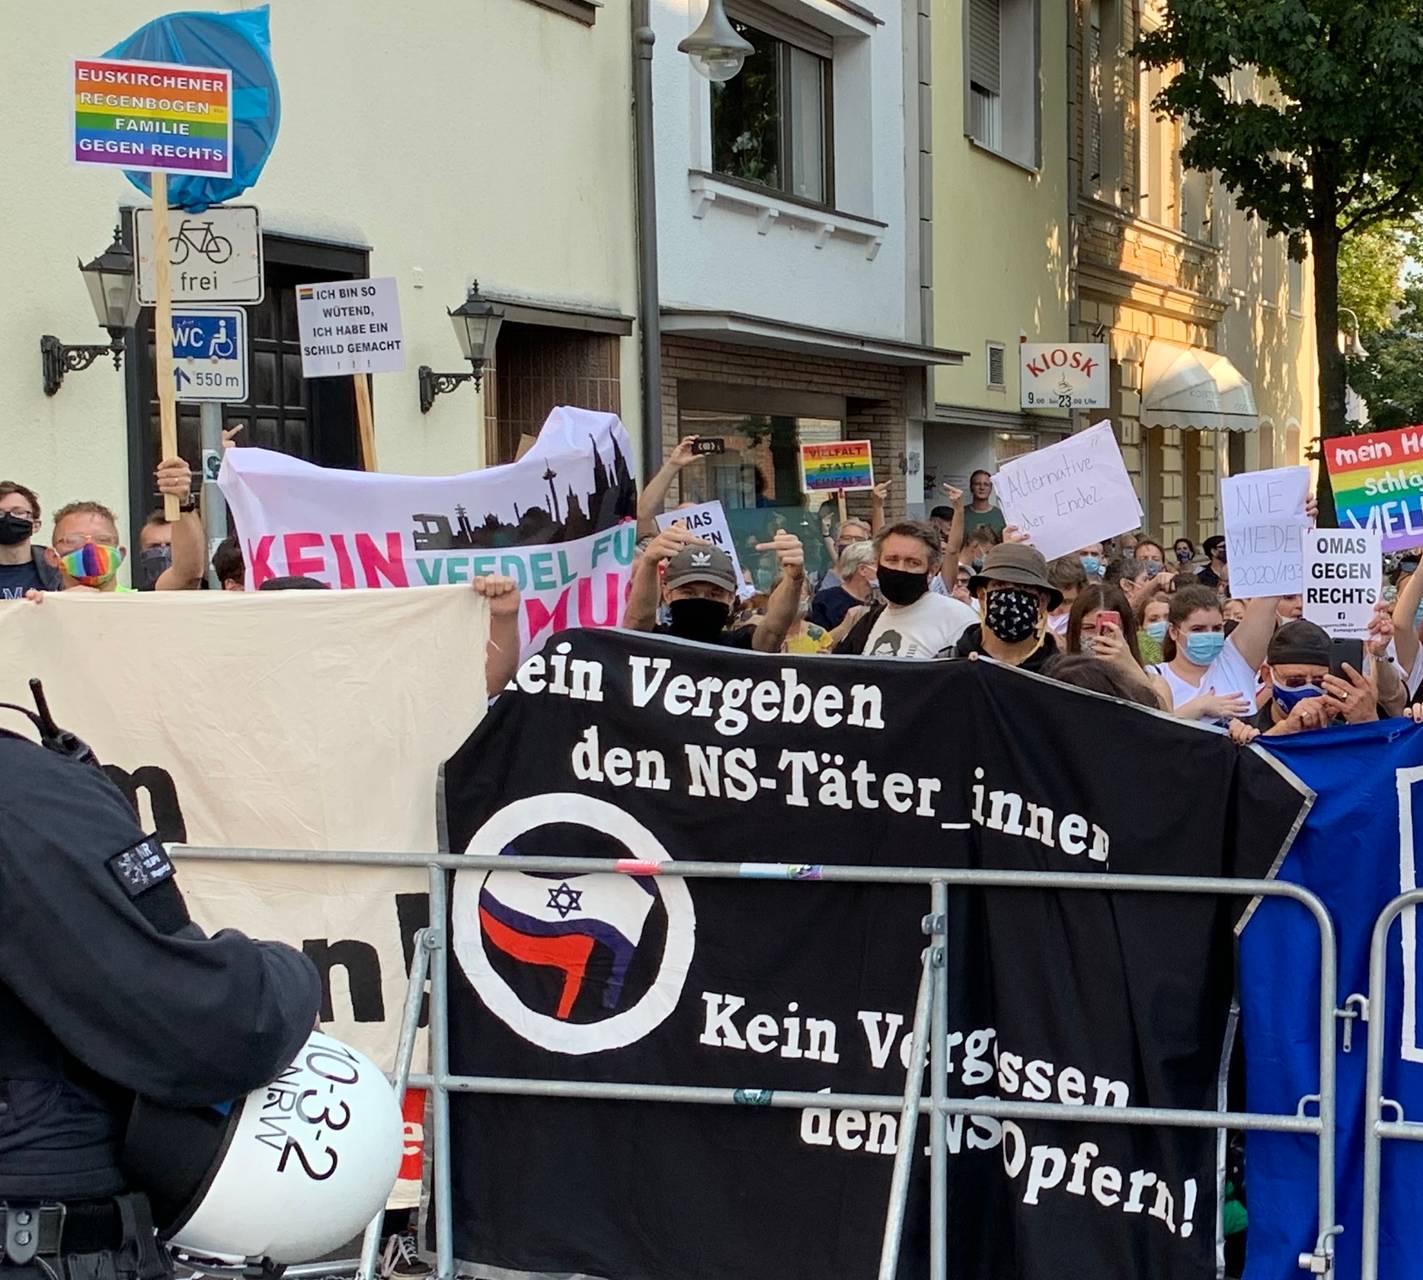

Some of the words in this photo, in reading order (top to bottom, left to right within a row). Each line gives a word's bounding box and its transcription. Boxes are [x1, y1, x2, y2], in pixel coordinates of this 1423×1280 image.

[78, 68, 223, 92] EUSKIRCHENER
[115, 118, 190, 135] FAMILIE
[79, 138, 144, 155] GEGEN
[151, 144, 223, 161] RECHTS
[181, 271, 218, 291] frei
[316, 289, 335, 300] ICH
[339, 288, 358, 298] BIN
[361, 286, 376, 296] SO
[172, 327, 204, 347] WC
[313, 327, 332, 337] ICH
[336, 324, 366, 335] HABE
[370, 323, 388, 333] EIN
[304, 345, 344, 356] SCHILD
[348, 340, 401, 353] GEMACHT
[1026, 349, 1098, 378] KIOSK
[196, 373, 222, 387] 550
[226, 376, 239, 386] m
[809, 447, 863, 457] VIELFALT
[1335, 440, 1392, 466] mein
[819, 462, 855, 471] STATT
[1236, 481, 1285, 516] NIE
[671, 512, 713, 530] MAS
[1317, 538, 1366, 554] OMAS
[248, 531, 409, 591] KEIN
[1312, 563, 1371, 579] GEGEN
[1307, 588, 1377, 604] RECHTS
[525, 573, 632, 644] MU
[504, 642, 604, 702] ein
[627, 655, 885, 736] Vergeben
[571, 725, 671, 791] den
[700, 991, 840, 1064] Kein
[857, 1010, 1130, 1109] Vergssen
